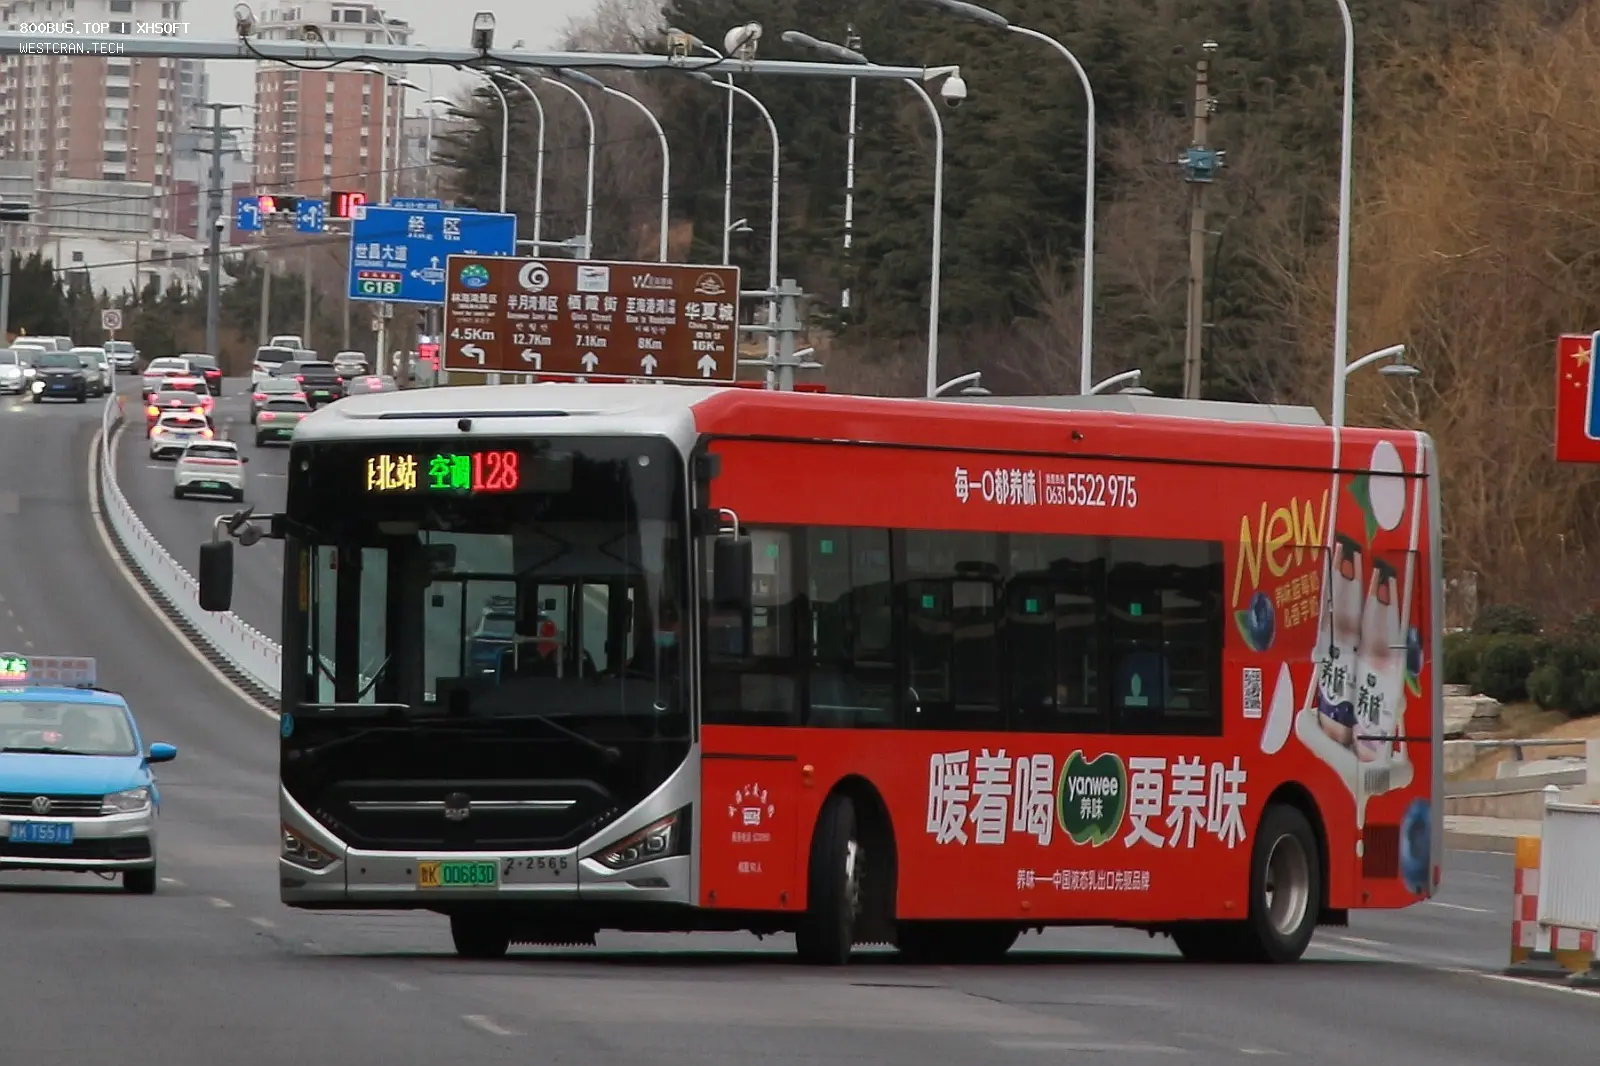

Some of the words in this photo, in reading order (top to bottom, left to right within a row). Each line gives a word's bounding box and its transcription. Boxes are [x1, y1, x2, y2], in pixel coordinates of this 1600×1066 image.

[363, 281, 396, 294] G18
[450, 327, 496, 340] 4.5Km
[512, 333, 552, 346] 12.7Km
[576, 334, 607, 348] 7.1Km
[428, 453, 470, 490] 空调
[473, 451, 518, 490] 128
[1045, 485, 1067, 505] 0631
[925, 748, 1055, 847] 暖着喝
[1123, 755, 1248, 849] 更养味
[1068, 776, 1119, 802] yanwee
[1080, 796, 1104, 820] 养味
